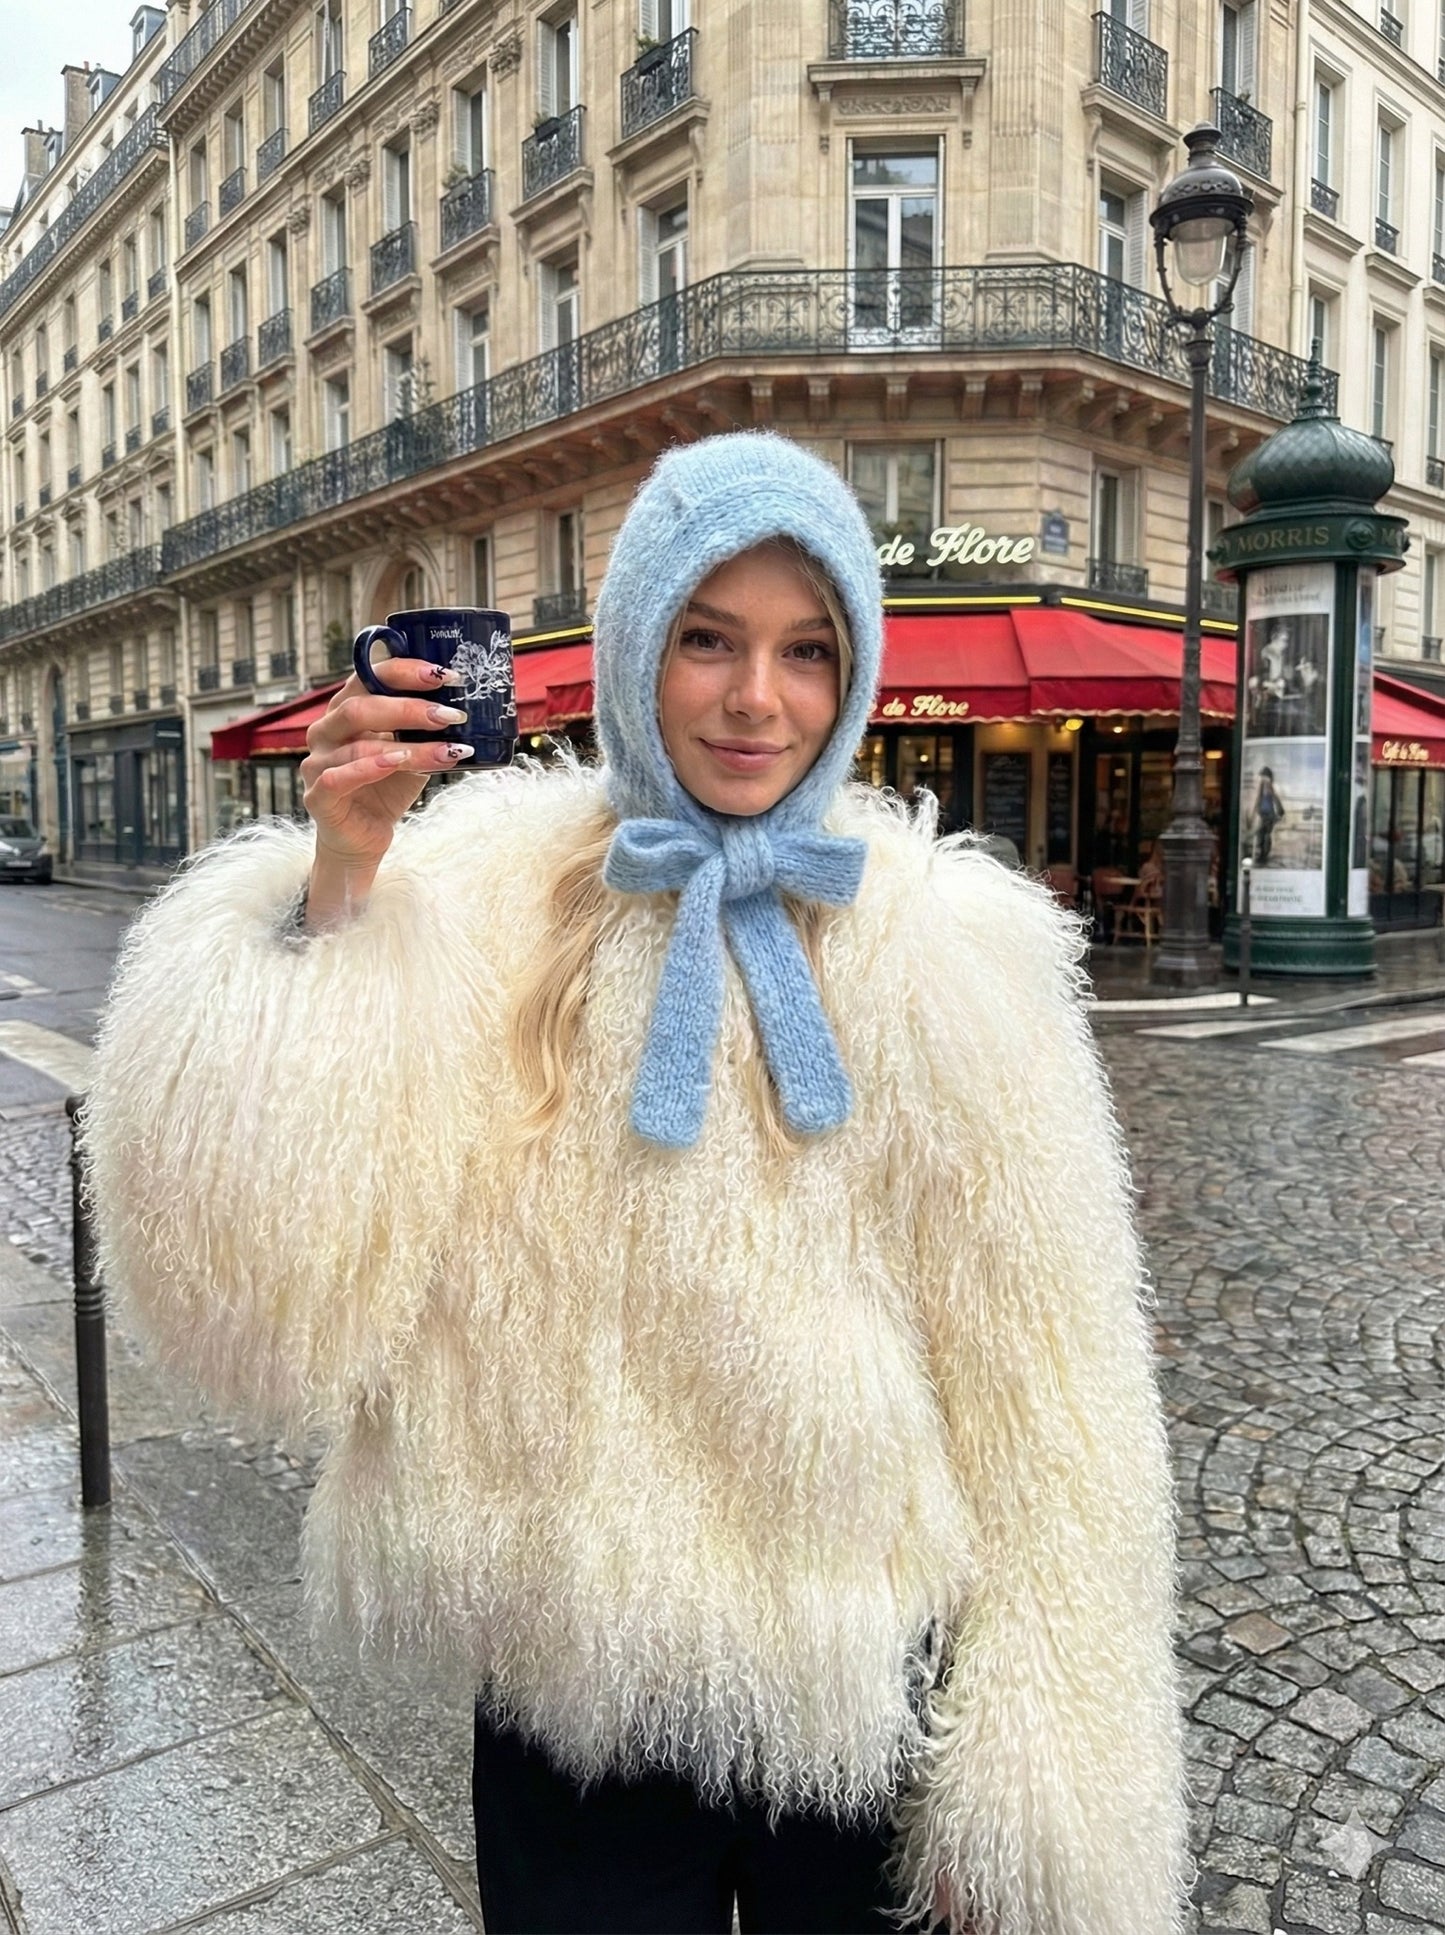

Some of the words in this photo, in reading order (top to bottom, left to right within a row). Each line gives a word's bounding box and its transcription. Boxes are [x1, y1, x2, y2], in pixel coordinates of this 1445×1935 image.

[876, 535, 915, 566] de
[926, 522, 1035, 567] Flore
[1237, 525, 1330, 553] MORRIS
[910, 695, 969, 716] Flore
